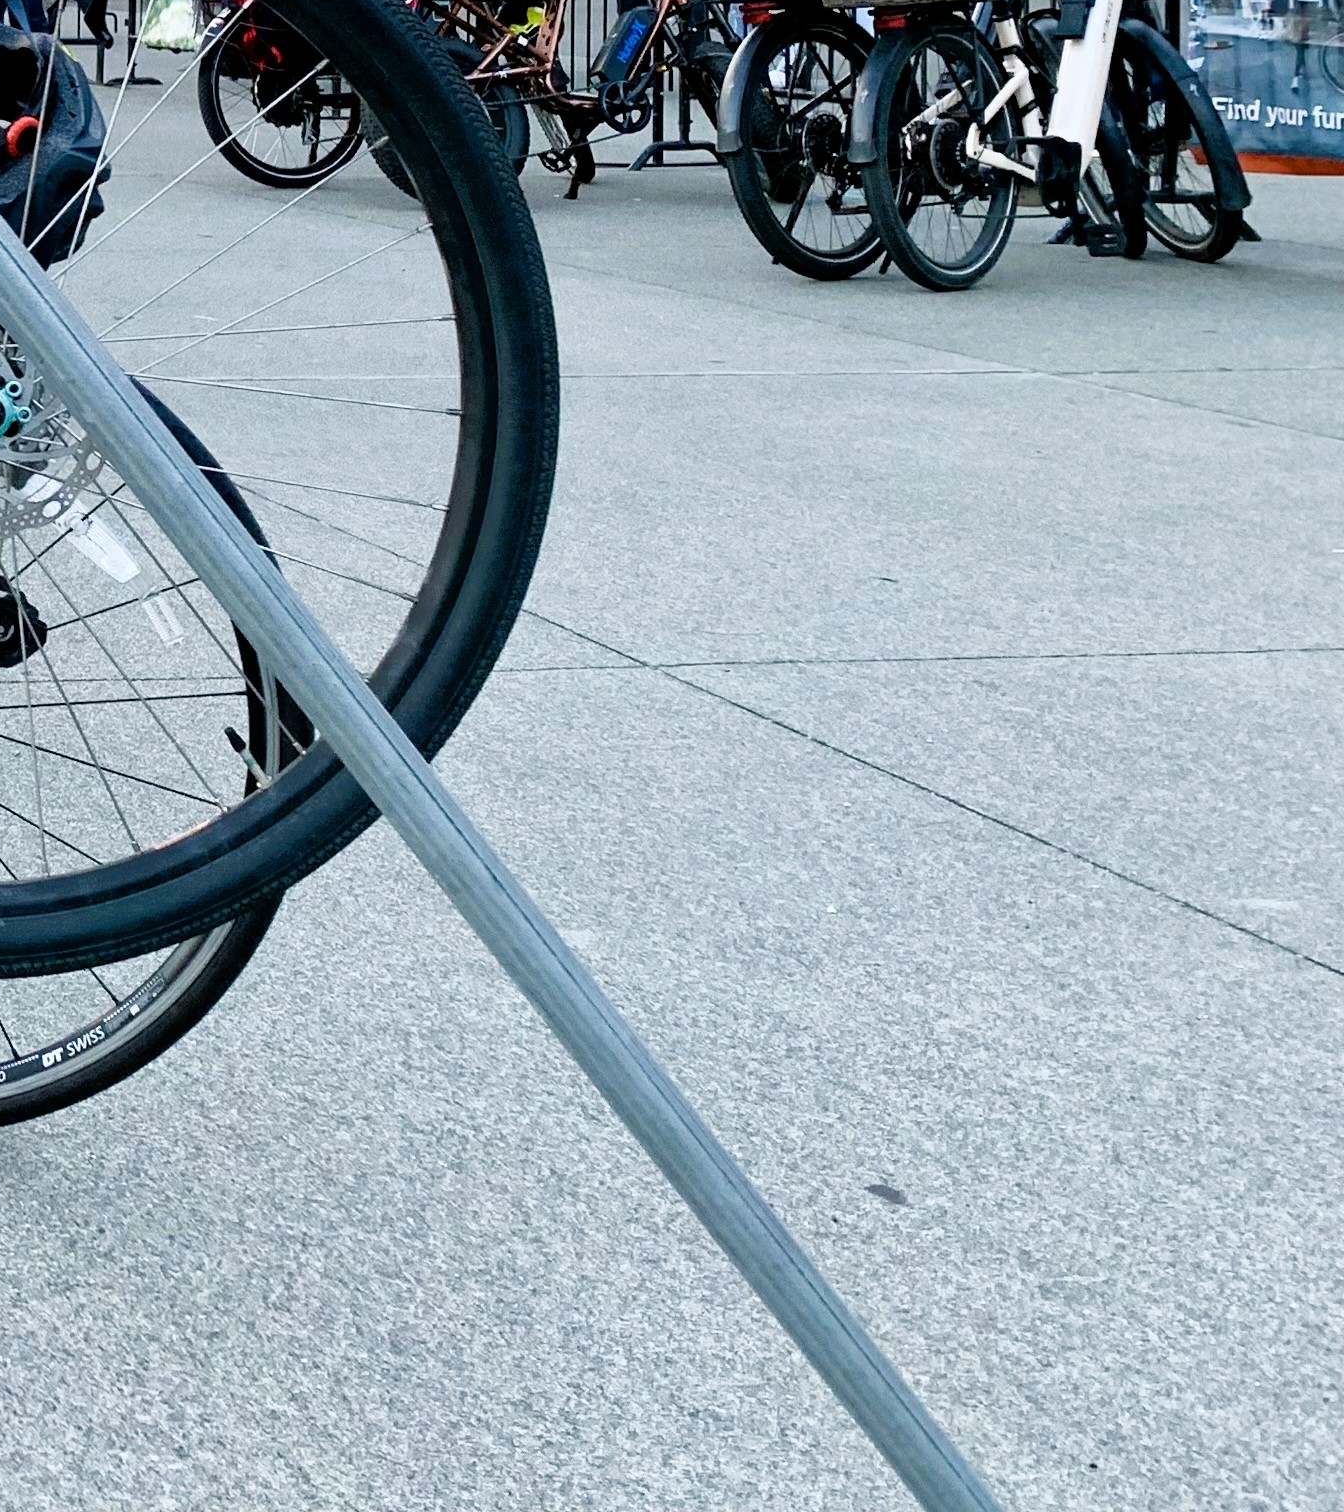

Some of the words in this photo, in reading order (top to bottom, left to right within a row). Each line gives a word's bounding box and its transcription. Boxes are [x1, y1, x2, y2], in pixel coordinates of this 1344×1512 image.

[1212, 97, 1261, 122] Find
[1263, 105, 1309, 128] your
[41, 1047, 65, 1068] DT
[66, 1025, 106, 1058] SWISS
